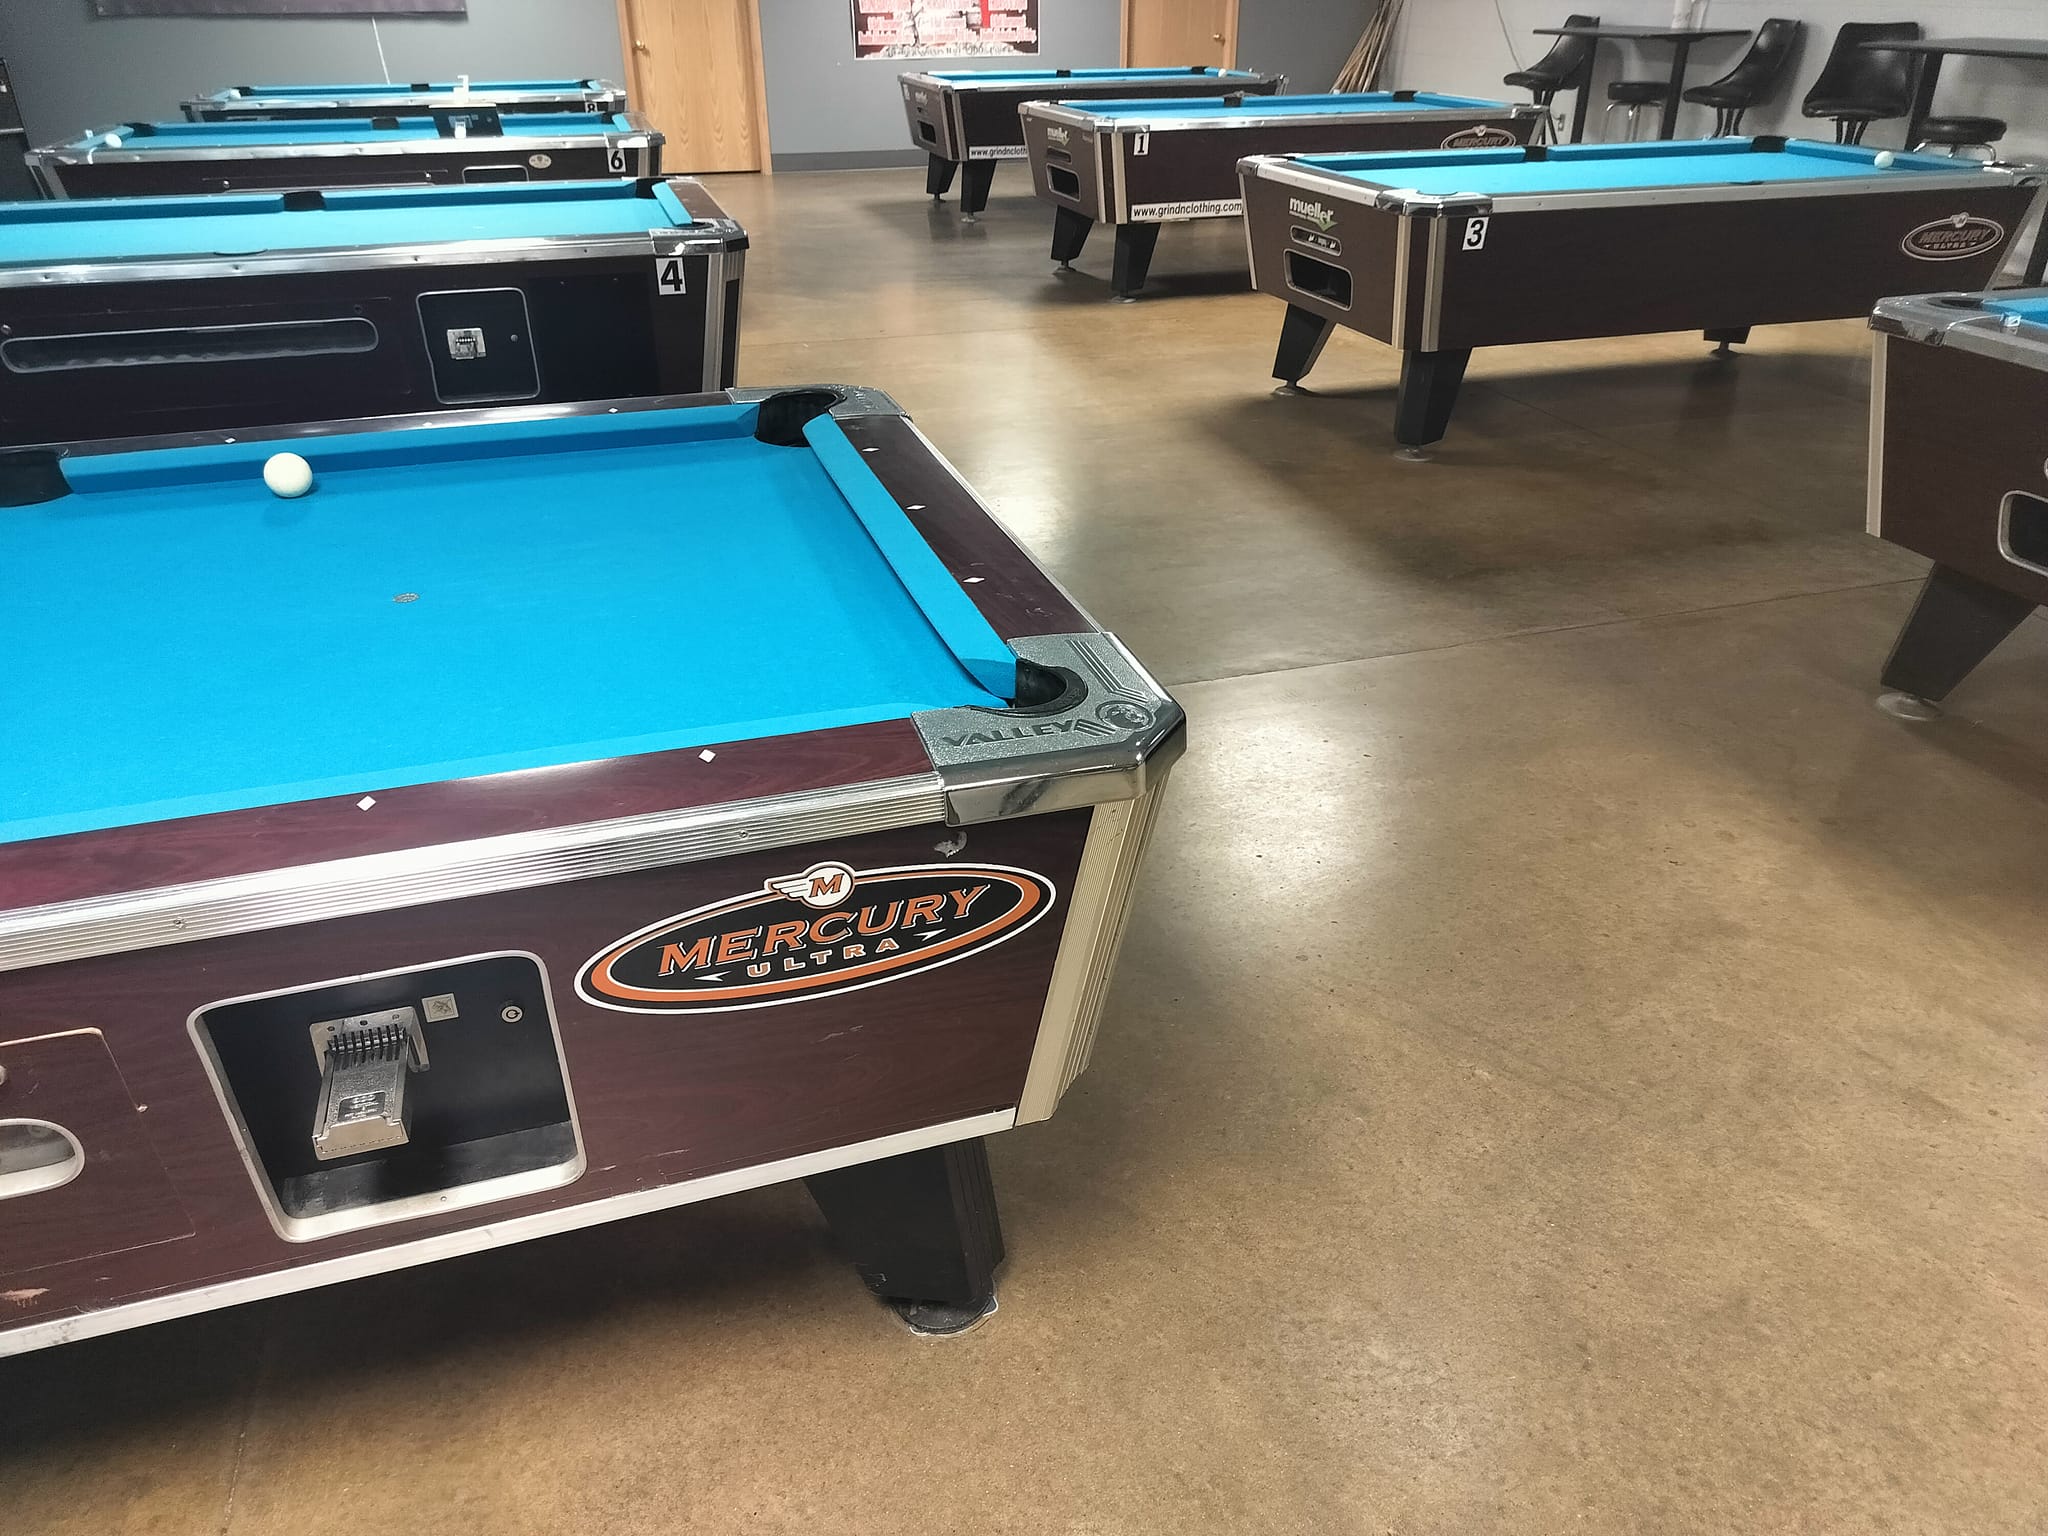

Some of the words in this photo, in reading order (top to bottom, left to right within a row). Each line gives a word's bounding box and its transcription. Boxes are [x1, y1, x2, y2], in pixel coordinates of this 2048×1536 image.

[1137, 135, 1145, 154] 1
[610, 150, 623, 170] 6
[1133, 202, 1242, 217] www.grindnclothing.com
[1289, 197, 1334, 224] mueller
[1467, 219, 1484, 247] 3
[660, 260, 683, 291] 4
[942, 719, 1075, 746] VALLEY
[808, 872, 844, 899] M
[658, 883, 991, 977] MERCURY
[746, 939, 899, 978] ULTRA
